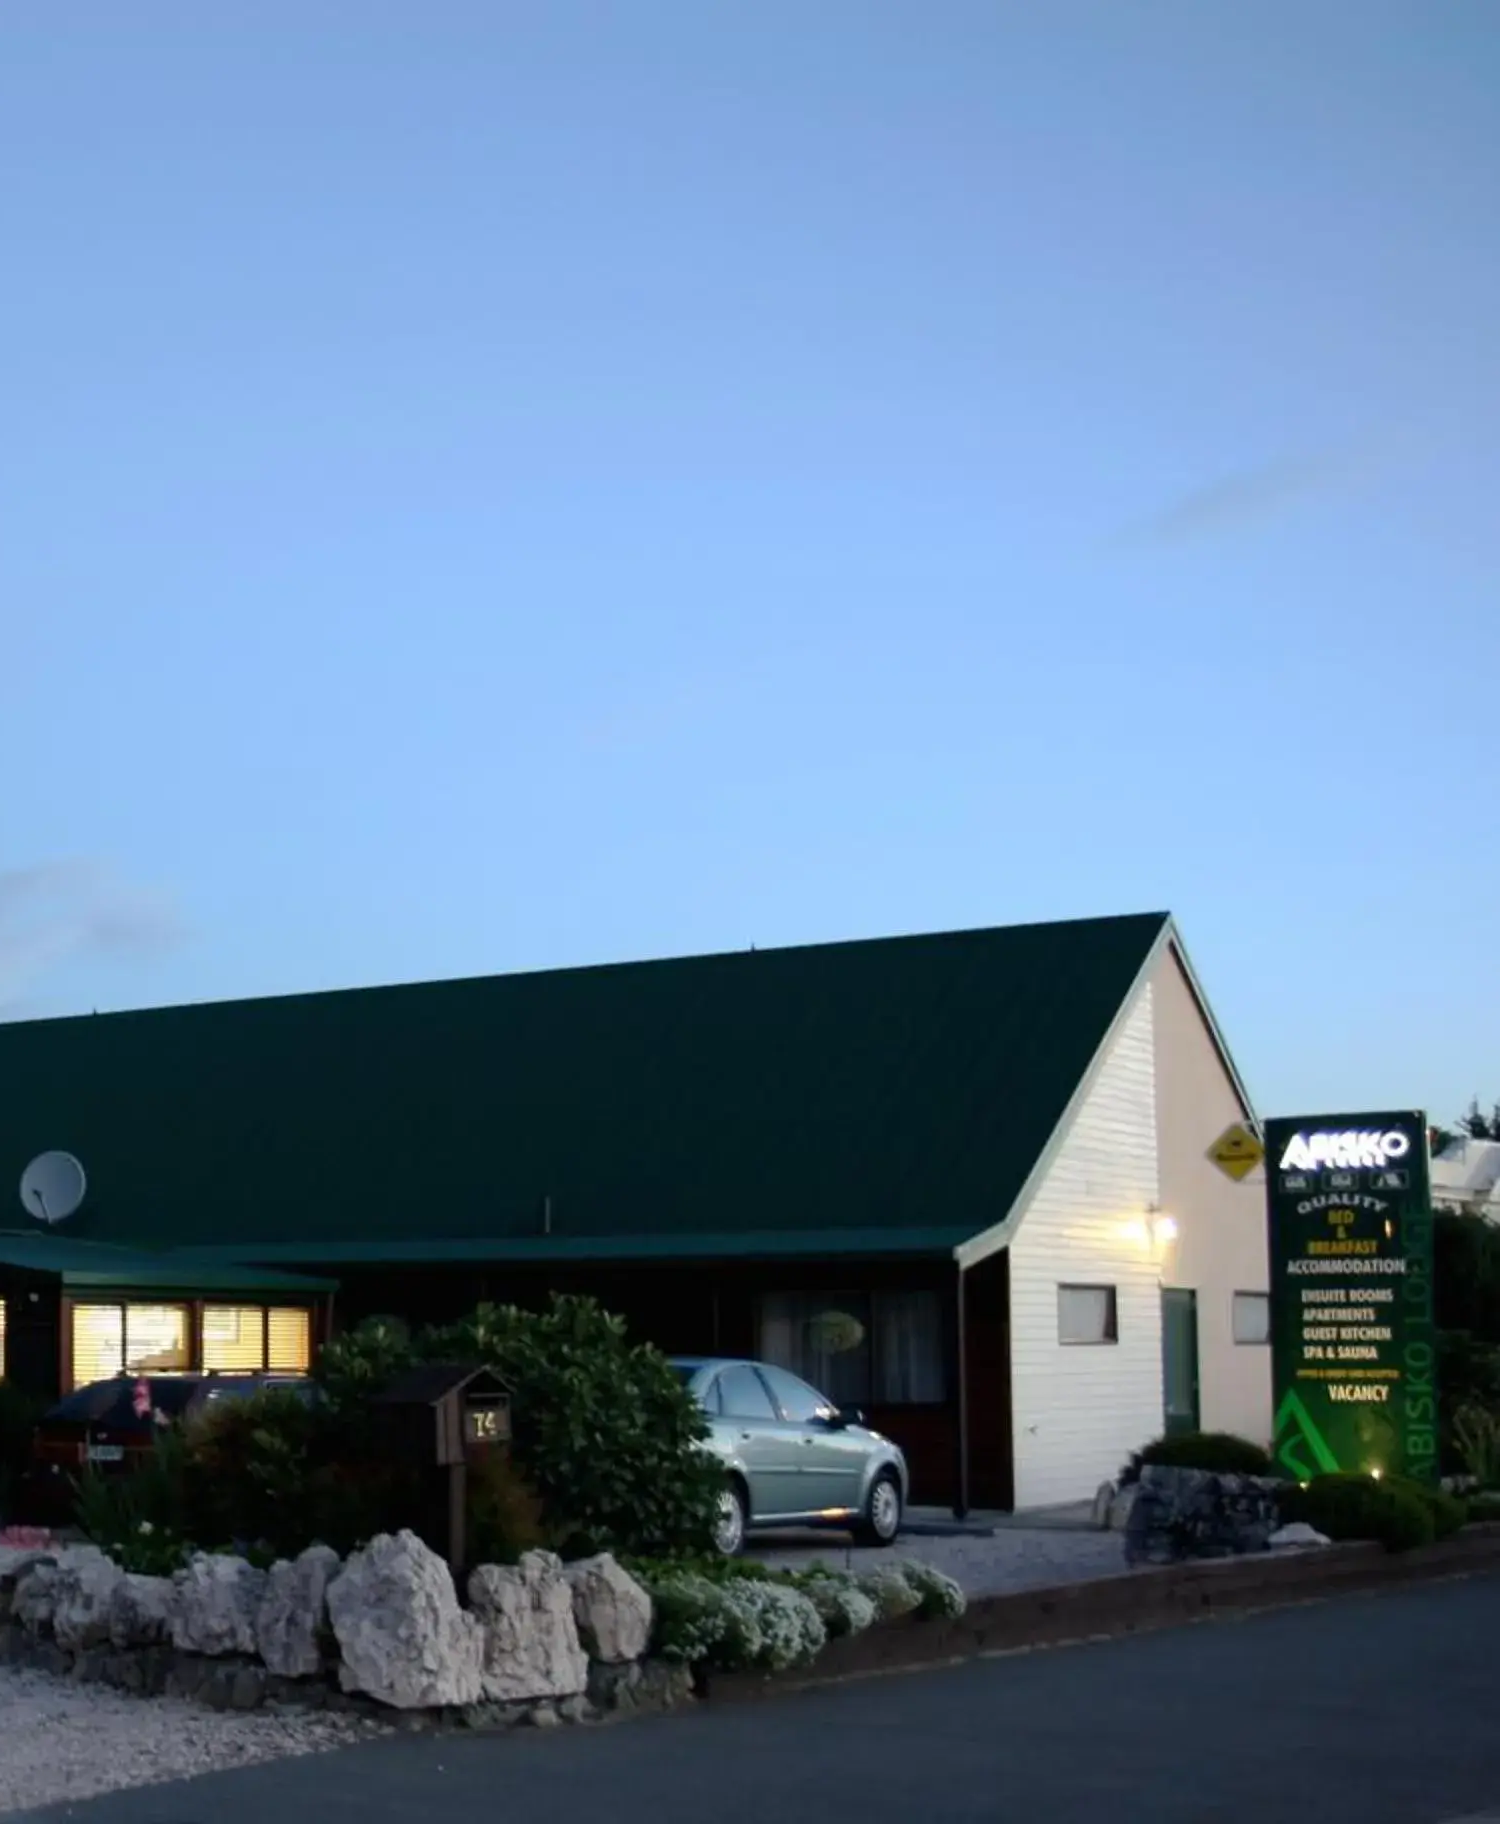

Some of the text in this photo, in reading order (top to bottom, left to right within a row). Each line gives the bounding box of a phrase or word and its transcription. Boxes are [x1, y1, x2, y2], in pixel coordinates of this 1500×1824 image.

[1297, 1193, 1389, 1214] QUALITY
[1328, 1210, 1354, 1224] BED
[1307, 1240, 1378, 1255] BREAKFAST
[1286, 1259, 1406, 1275] ACCOMMODATION
[1301, 1288, 1394, 1303] ENSUITE ROOMS
[1302, 1308, 1376, 1322] APARTMENTS
[1303, 1326, 1393, 1341] GUEST KITCHEN
[1303, 1346, 1324, 1360] SPA
[1337, 1345, 1379, 1360] SAUNA
[1328, 1384, 1390, 1401] VACANCY
[1403, 1341, 1436, 1480] ABISKO
